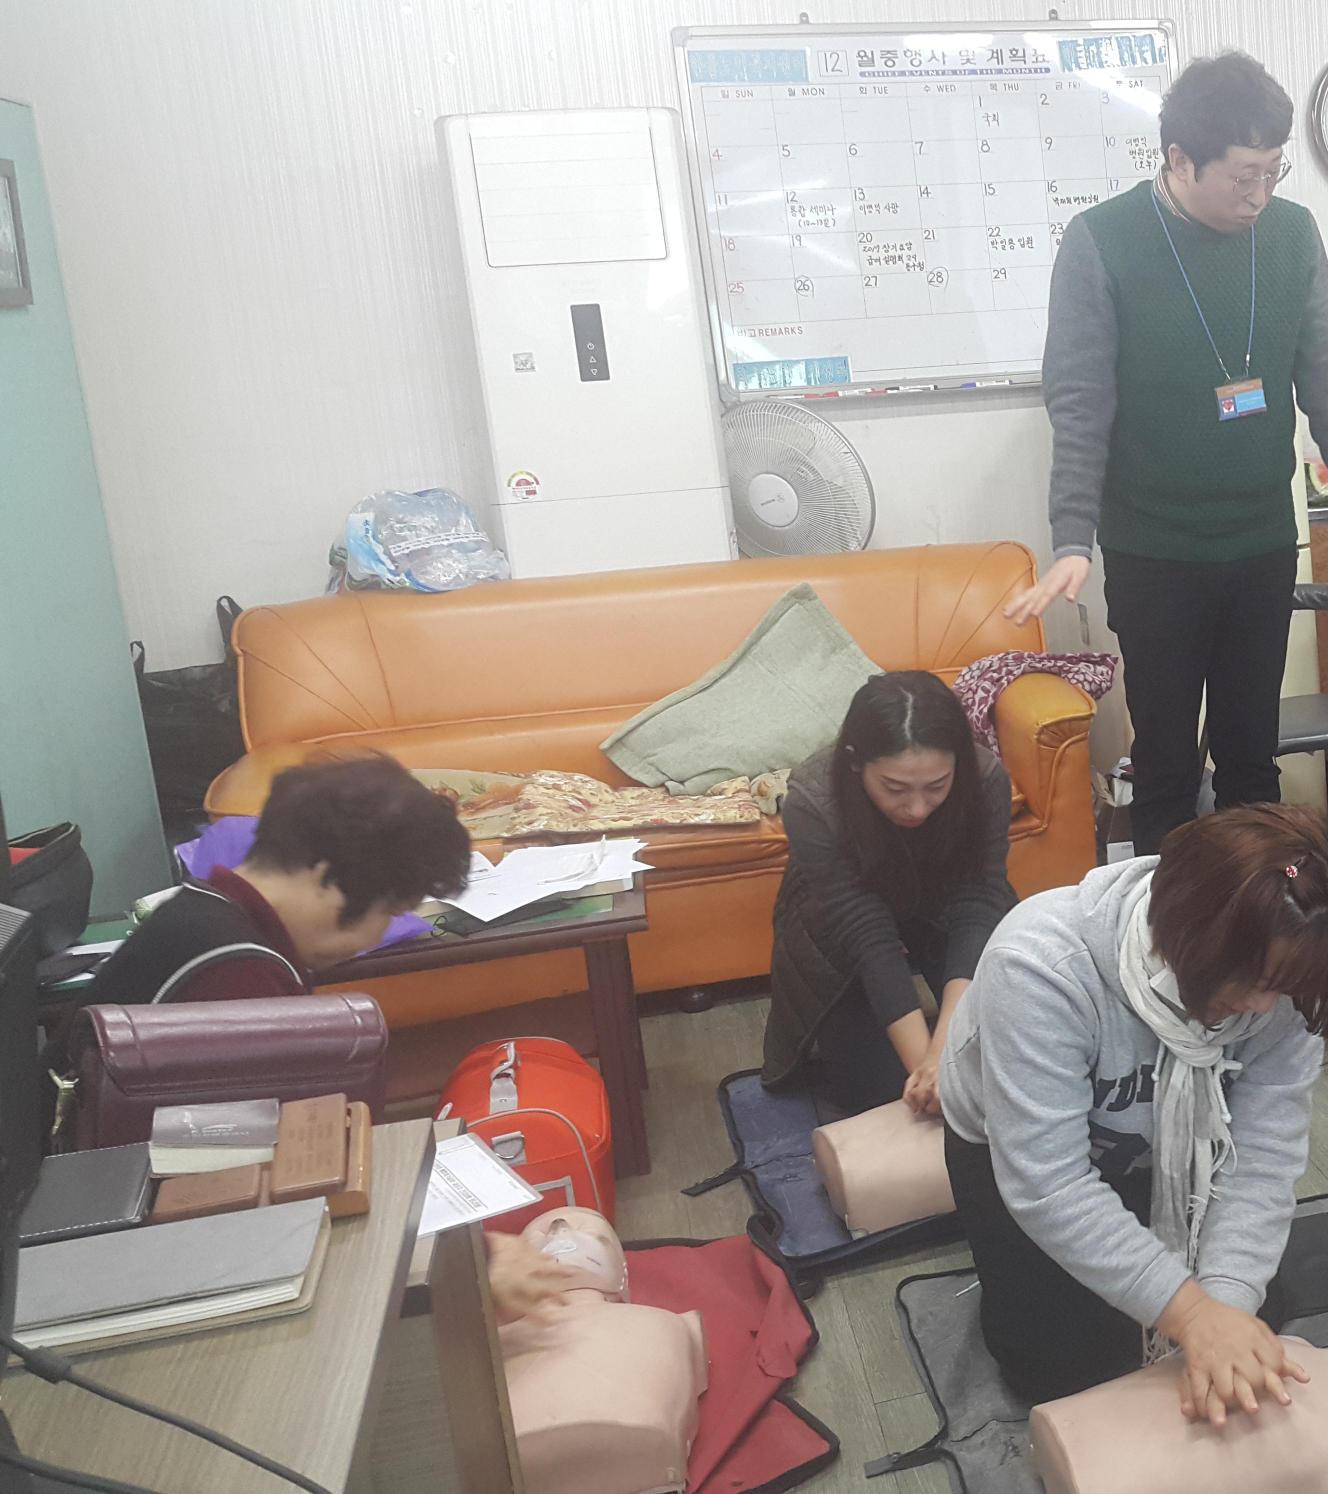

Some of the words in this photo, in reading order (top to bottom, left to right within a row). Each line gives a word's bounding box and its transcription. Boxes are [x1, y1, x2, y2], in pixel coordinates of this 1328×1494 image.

[823, 51, 844, 74] 12
[856, 48, 946, 68] 월중행사
[959, 48, 977, 66] 및
[986, 47, 1050, 65] 계획표
[904, 69, 955, 77] EVENTS
[1002, 67, 1047, 75] MONTH
[923, 84, 931, 93] 수
[936, 84, 957, 93] WED
[1003, 83, 1019, 91] THU
[1068, 81, 1081, 89] FRI
[1128, 80, 1144, 88] SAT
[735, 88, 754, 98] SUN
[801, 87, 826, 96] MON
[873, 86, 889, 95] TUE
[977, 95, 983, 108] 1
[1039, 93, 1049, 106] 2
[1102, 92, 1110, 105] 3
[980, 139, 991, 153] 8
[1044, 137, 1053, 151] 9
[1105, 135, 1116, 147] 10
[781, 144, 791, 158] 5
[848, 143, 858, 156] 6
[914, 141, 924, 155] 7
[712, 149, 723, 161] 4
[984, 183, 996, 196] 15
[1047, 180, 1058, 193] 16
[1109, 179, 1119, 191] 17
[786, 191, 798, 203] 12
[854, 188, 865, 201] 13
[918, 185, 931, 198] 14
[717, 194, 728, 206] 11
[810, 203, 837, 216] 세미나
[884, 202, 899, 215] 사망
[923, 229, 936, 240] 21
[987, 226, 1001, 237] 22
[1050, 223, 1065, 235] 23
[791, 235, 802, 247] 19
[857, 232, 873, 243] 20
[1018, 235, 1034, 249] 입원
[723, 238, 736, 251] 18
[928, 272, 944, 284] 28
[992, 268, 1007, 280] 29
[797, 279, 810, 291] 26
[863, 275, 878, 287] 27
[728, 281, 744, 294] 25
[758, 326, 804, 337] REMARKS
